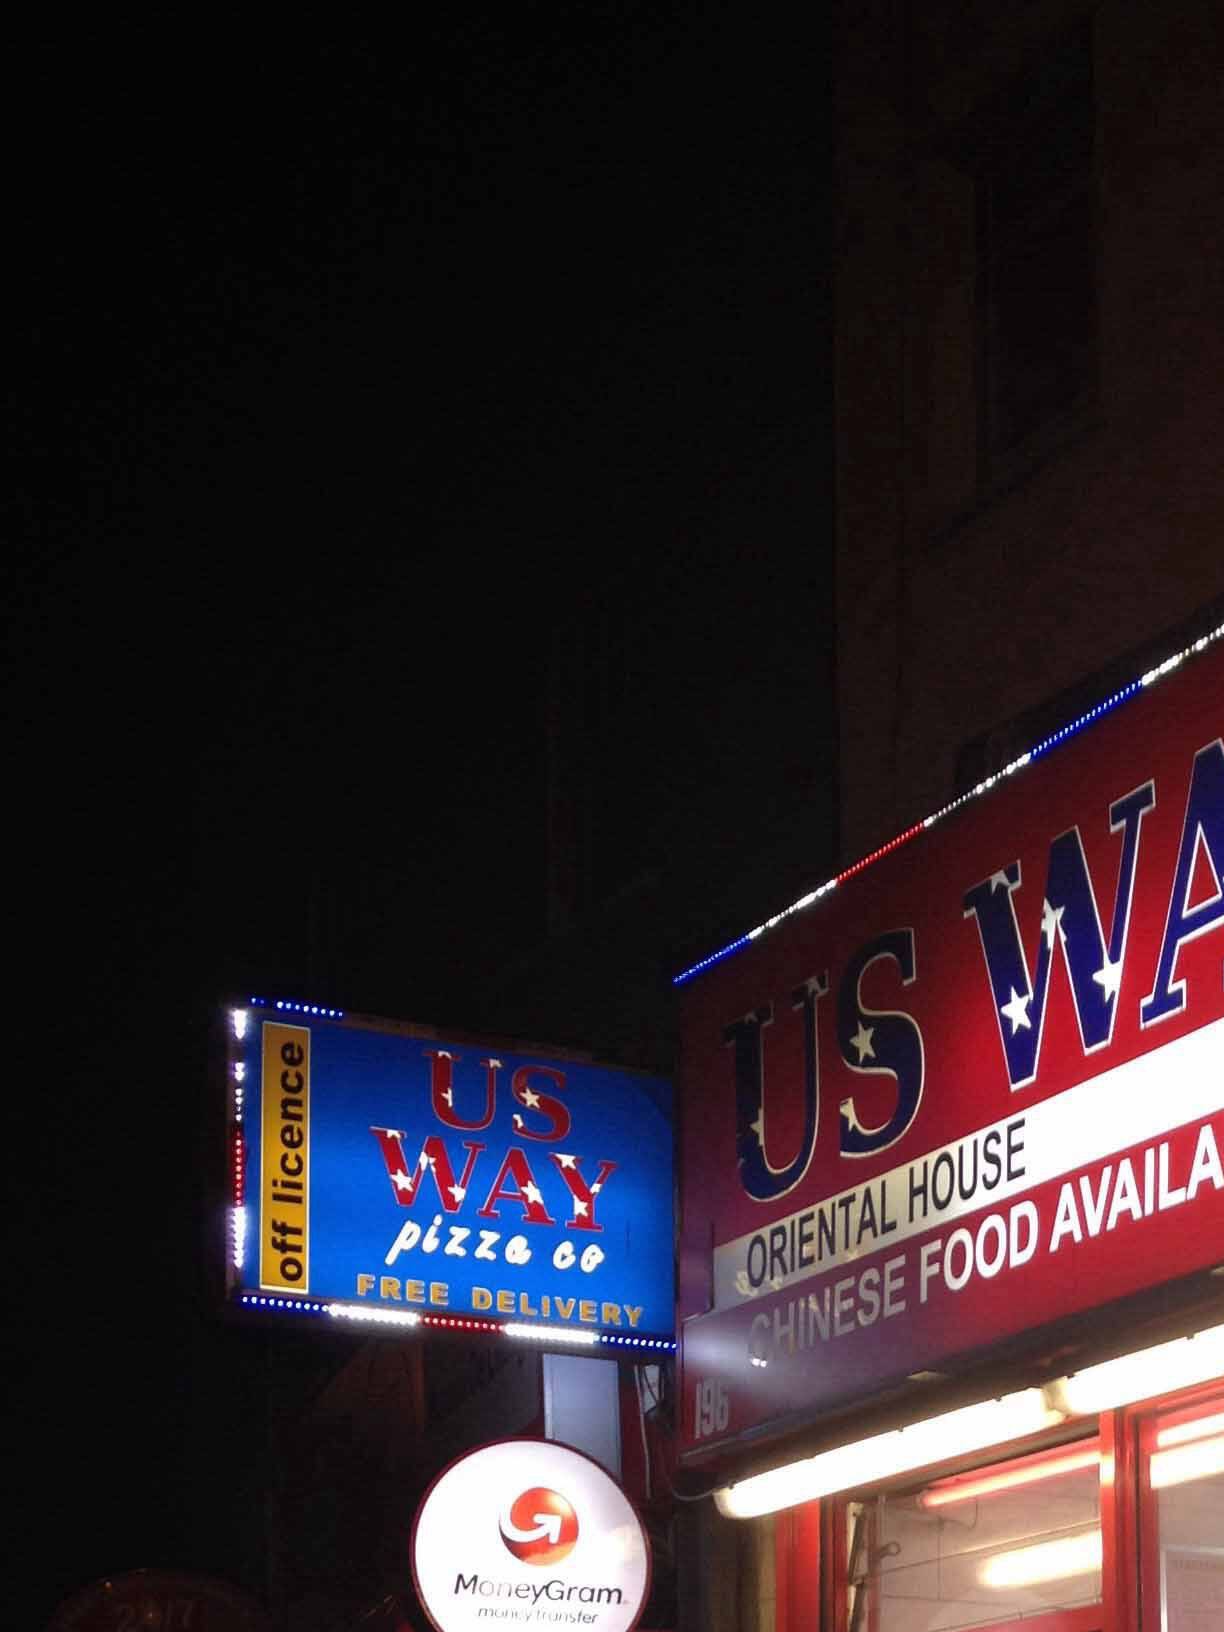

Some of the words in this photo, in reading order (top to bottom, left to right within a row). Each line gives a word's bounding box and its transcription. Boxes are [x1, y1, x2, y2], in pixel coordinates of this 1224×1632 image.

[424, 1050, 571, 1143] US
[722, 927, 925, 1203] US
[271, 1039, 305, 1205] licence
[369, 1126, 618, 1231] WAY
[747, 1179, 897, 1289] ORIENTAL
[908, 1117, 1026, 1224] HOUSE
[271, 1221, 305, 1282] off
[385, 1214, 533, 1266] pizza
[750, 1254, 906, 1358] CHINESE
[920, 1199, 1039, 1304] FOOD
[357, 1273, 449, 1307] FREE
[472, 1286, 644, 1329] DELIVERY
